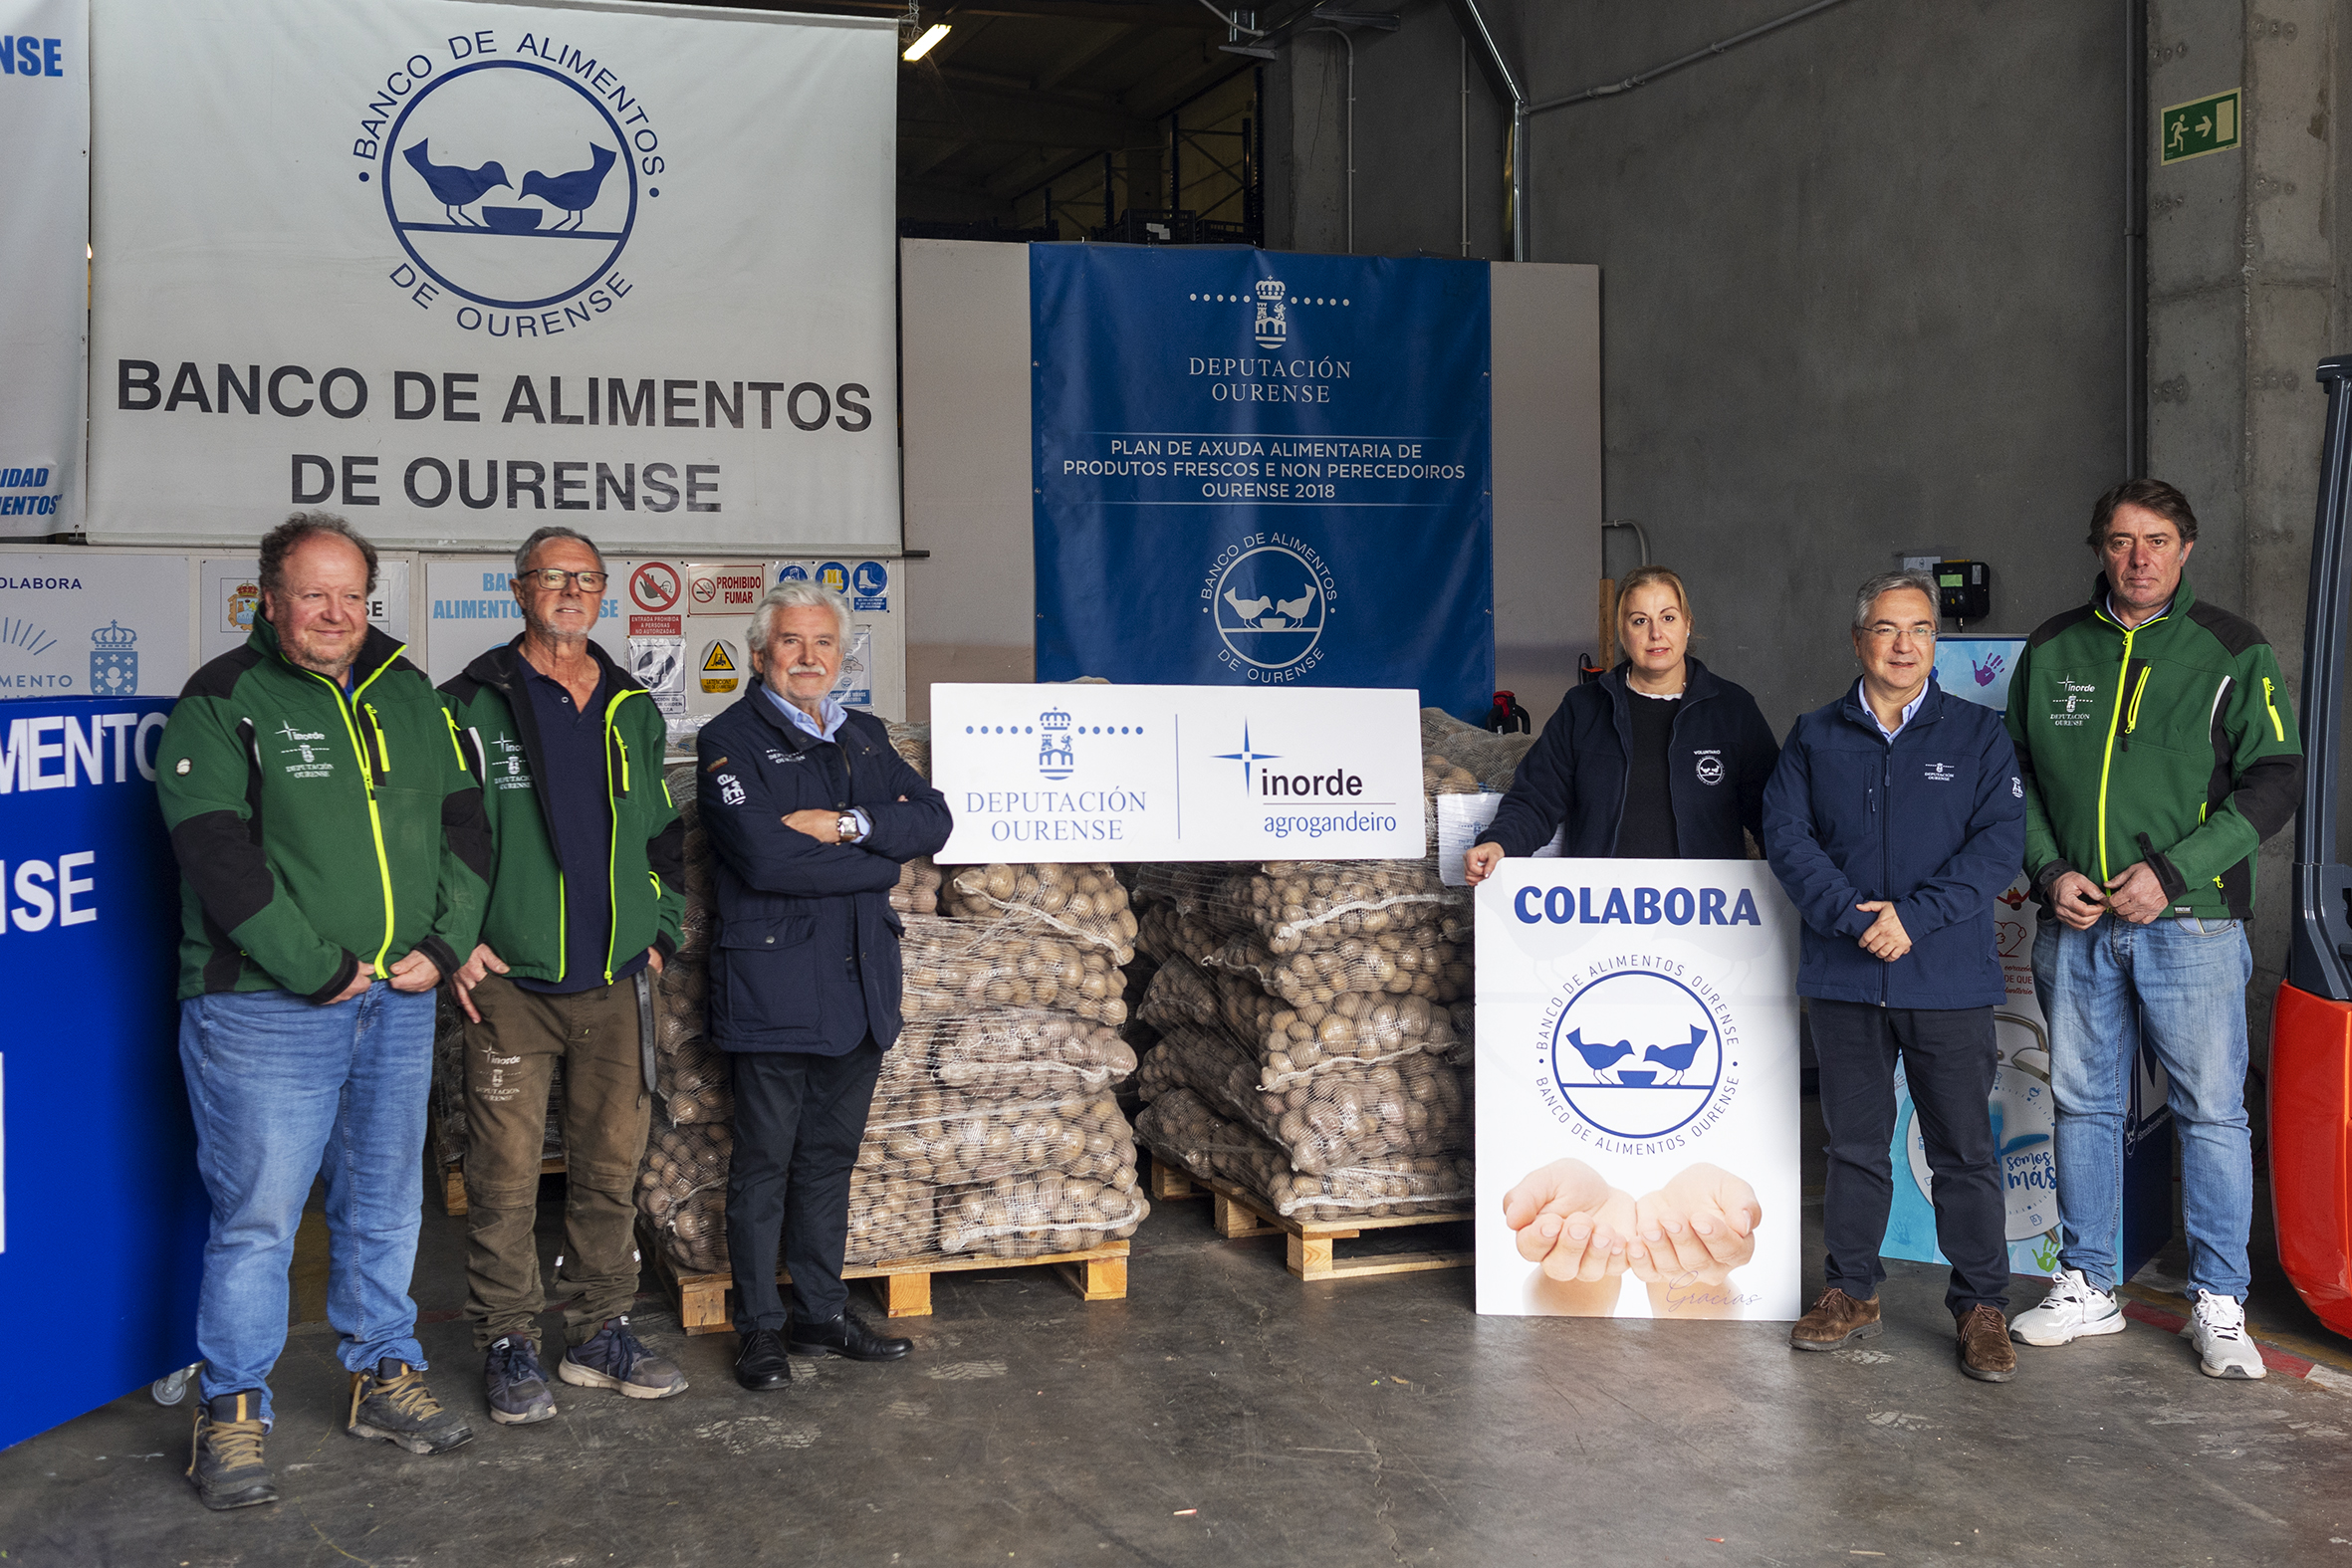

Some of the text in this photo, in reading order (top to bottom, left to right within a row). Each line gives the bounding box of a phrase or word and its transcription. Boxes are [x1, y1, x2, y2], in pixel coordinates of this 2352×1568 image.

[0, 35, 63, 77] NSE
[353, 30, 664, 175] BANCO DE ALIMENTOS
[389, 263, 633, 337] DE OURENSE
[1190, 356, 1350, 377] DEPUTACIÓN
[118, 359, 871, 432] BANCO DE ALIMENTOS
[1213, 383, 1329, 402] OURENSE
[1112, 440, 1421, 458] PLAN DE AXUDA ALIMENTARIA DE
[0, 468, 49, 488] IDAD
[292, 454, 721, 512] DE OURENSE
[1064, 461, 1465, 479] PRODUTOS FRESCOS E NON PERECEDOIROS
[1203, 483, 1334, 498] OURENSE 2018
[1201, 532, 1337, 600] BANCO DE ALIMENTOS
[717, 576, 761, 589] PROHIBIDO
[725, 591, 753, 603] FUMAR
[1218, 647, 1324, 683] DE OURENSE
[1263, 769, 1362, 795] inorde
[968, 785, 1145, 812] DEPUTACIÓN
[992, 820, 1122, 840] OURENSE
[1265, 811, 1396, 837] agrogandeiro
[1515, 886, 1762, 926] COLABORA
[2016, 975, 2032, 985] QUE
[1535, 955, 1740, 1050] BANCO DE ALIMENTOS OURENSE
[491, 1055, 521, 1064] inorde
[1535, 1076, 1740, 1156] BANCO DE ALIMENTOS OURENSE
[2006, 1152, 2052, 1171] somos
[2007, 1165, 2057, 1191] más
[1666, 1270, 1762, 1312] Gracias
